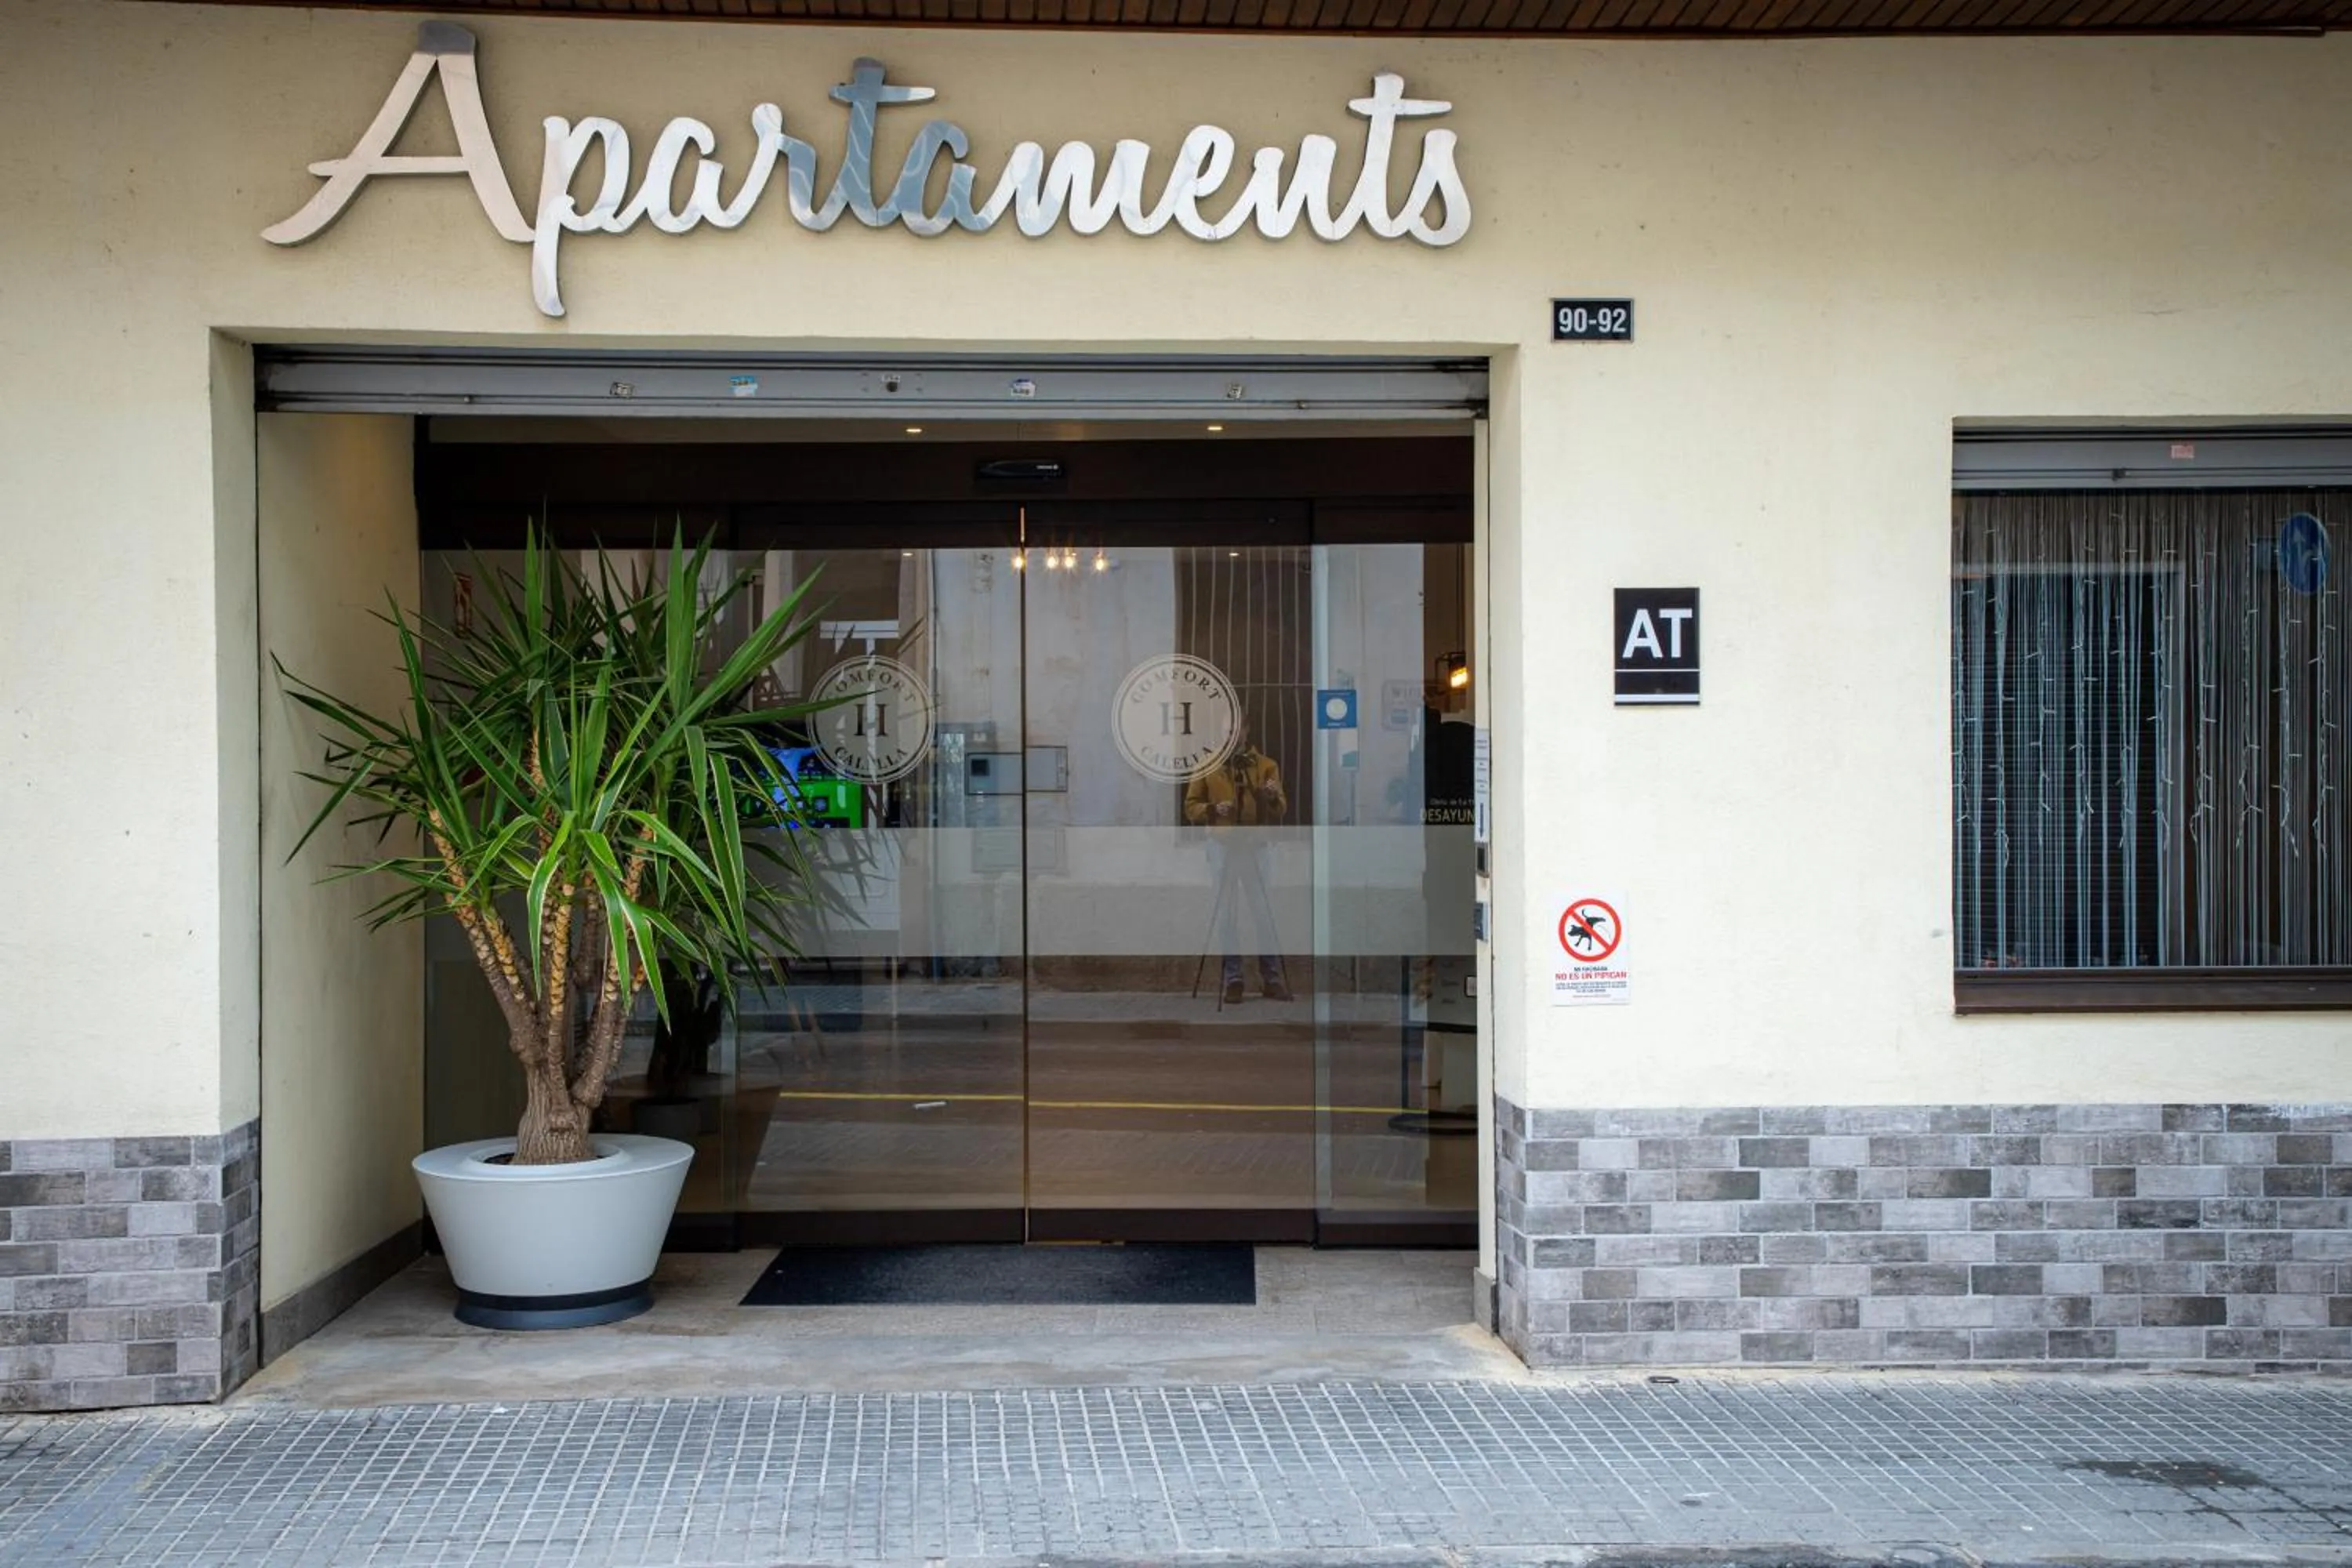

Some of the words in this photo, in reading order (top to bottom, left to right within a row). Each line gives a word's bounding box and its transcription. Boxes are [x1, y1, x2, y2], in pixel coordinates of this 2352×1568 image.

[260, 20, 1472, 317] Apartaments
[1559, 307, 1627, 333] 90-92
[1622, 608, 1693, 659] AT
[1131, 668, 1221, 703] COMFORT
[1159, 702, 1192, 735] H
[1141, 746, 1213, 769] CALELLA
